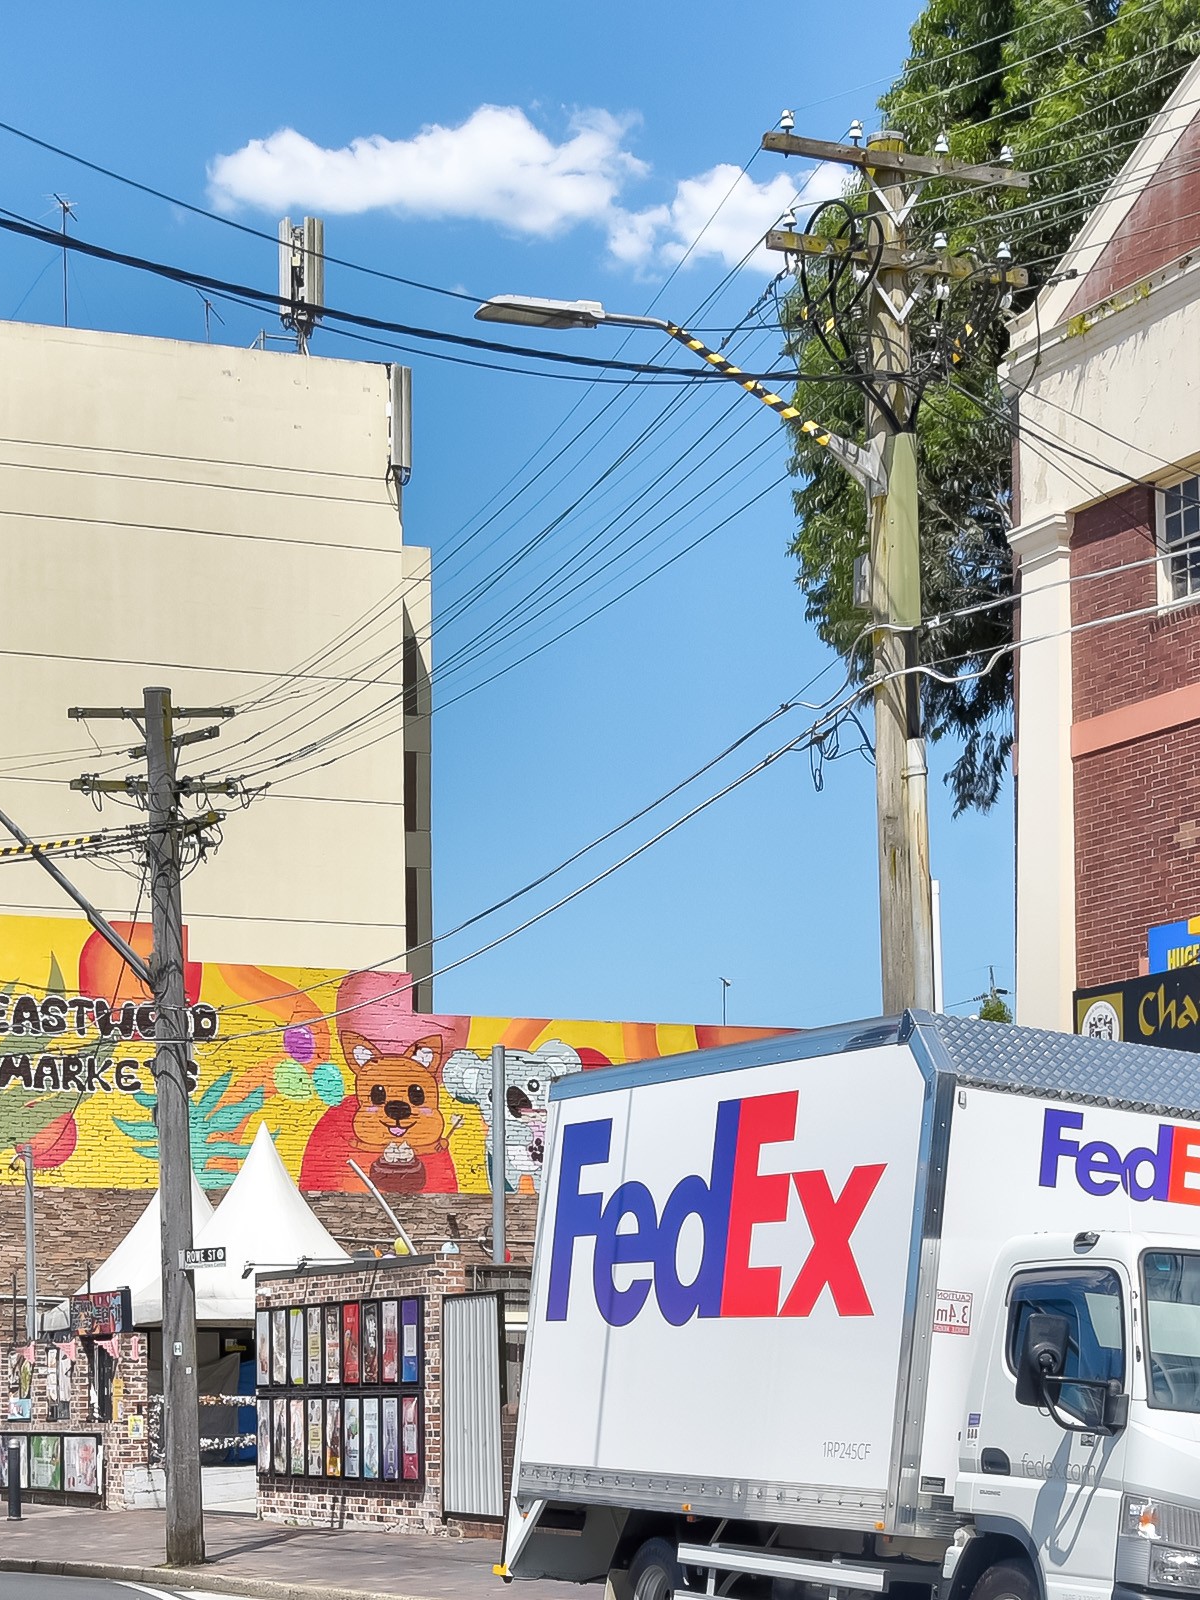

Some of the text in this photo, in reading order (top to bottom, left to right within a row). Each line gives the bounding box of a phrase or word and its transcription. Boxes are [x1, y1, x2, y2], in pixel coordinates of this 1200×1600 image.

[545, 1090, 888, 1327] FedEx
[186, 1249, 217, 1262] ROWE ST
[822, 1441, 872, 1460] 1RP245CF
[1020, 1452, 1097, 1482] fedex.com
